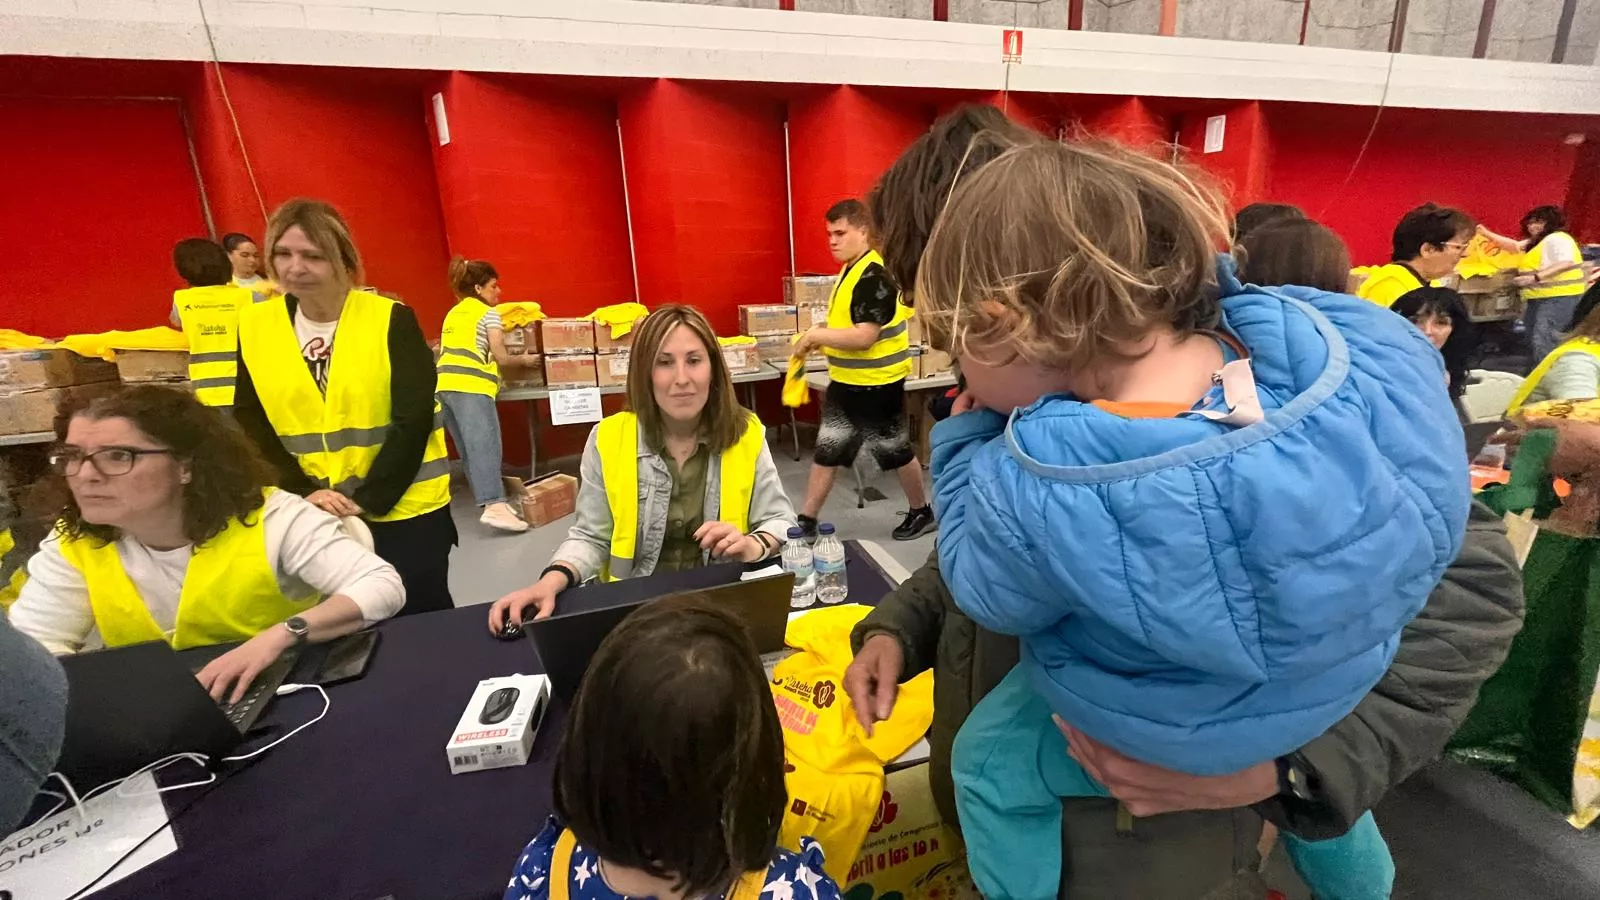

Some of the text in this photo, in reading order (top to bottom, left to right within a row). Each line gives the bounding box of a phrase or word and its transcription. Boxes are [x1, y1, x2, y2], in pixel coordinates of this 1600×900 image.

[457, 728, 508, 742] WIRELESS
[0, 838, 68, 872] ONES
[877, 853, 886, 870] a
[889, 846, 909, 868] las
[913, 839, 927, 858] 10
